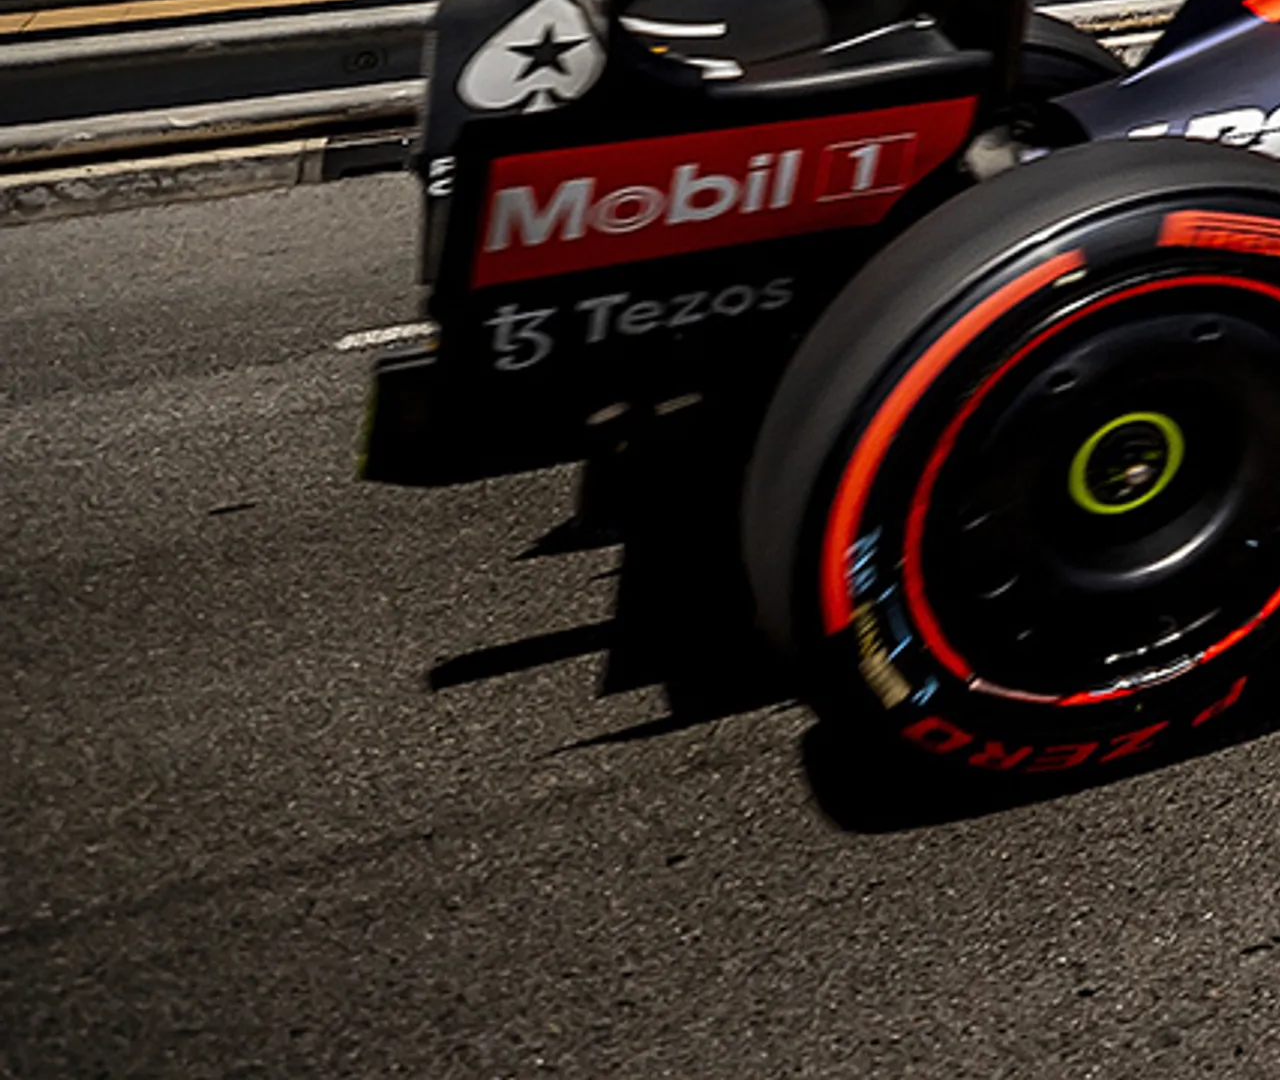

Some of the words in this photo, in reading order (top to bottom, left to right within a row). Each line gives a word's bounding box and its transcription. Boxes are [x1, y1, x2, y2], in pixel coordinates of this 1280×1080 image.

[484, 148, 805, 244] Mobil
[572, 276, 795, 345] Tezos
[900, 716, 1172, 773] ZERO
